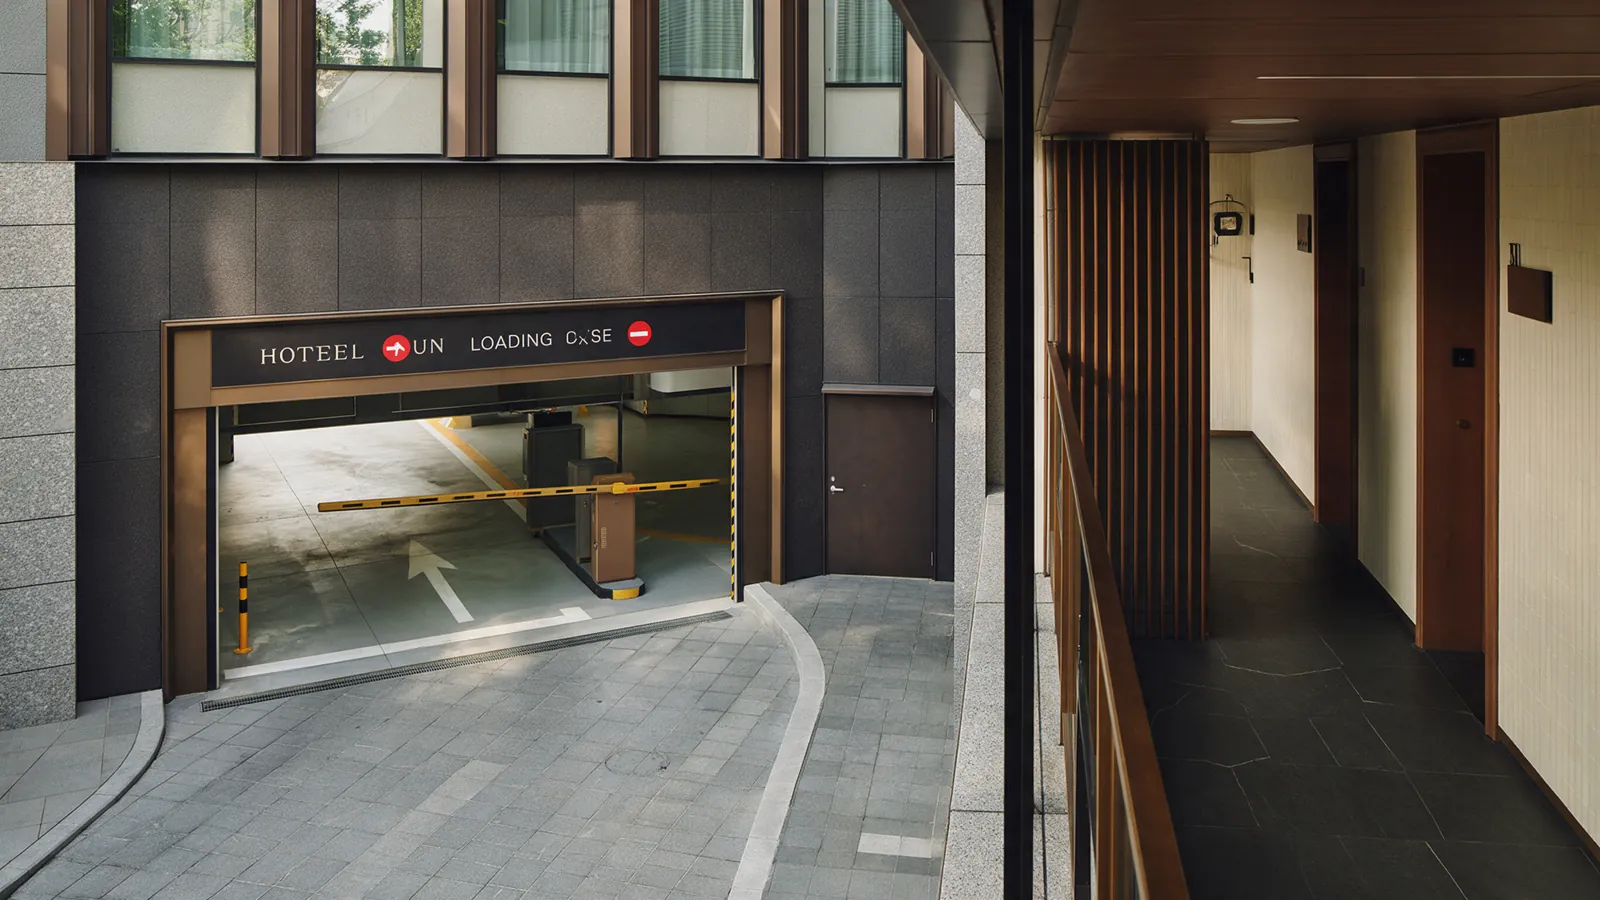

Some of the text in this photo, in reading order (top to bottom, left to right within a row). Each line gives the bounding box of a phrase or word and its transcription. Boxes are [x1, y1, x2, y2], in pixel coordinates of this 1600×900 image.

[260, 343, 365, 365] HOTEEL
[413, 337, 445, 355] UN
[471, 331, 553, 353] LOADING
